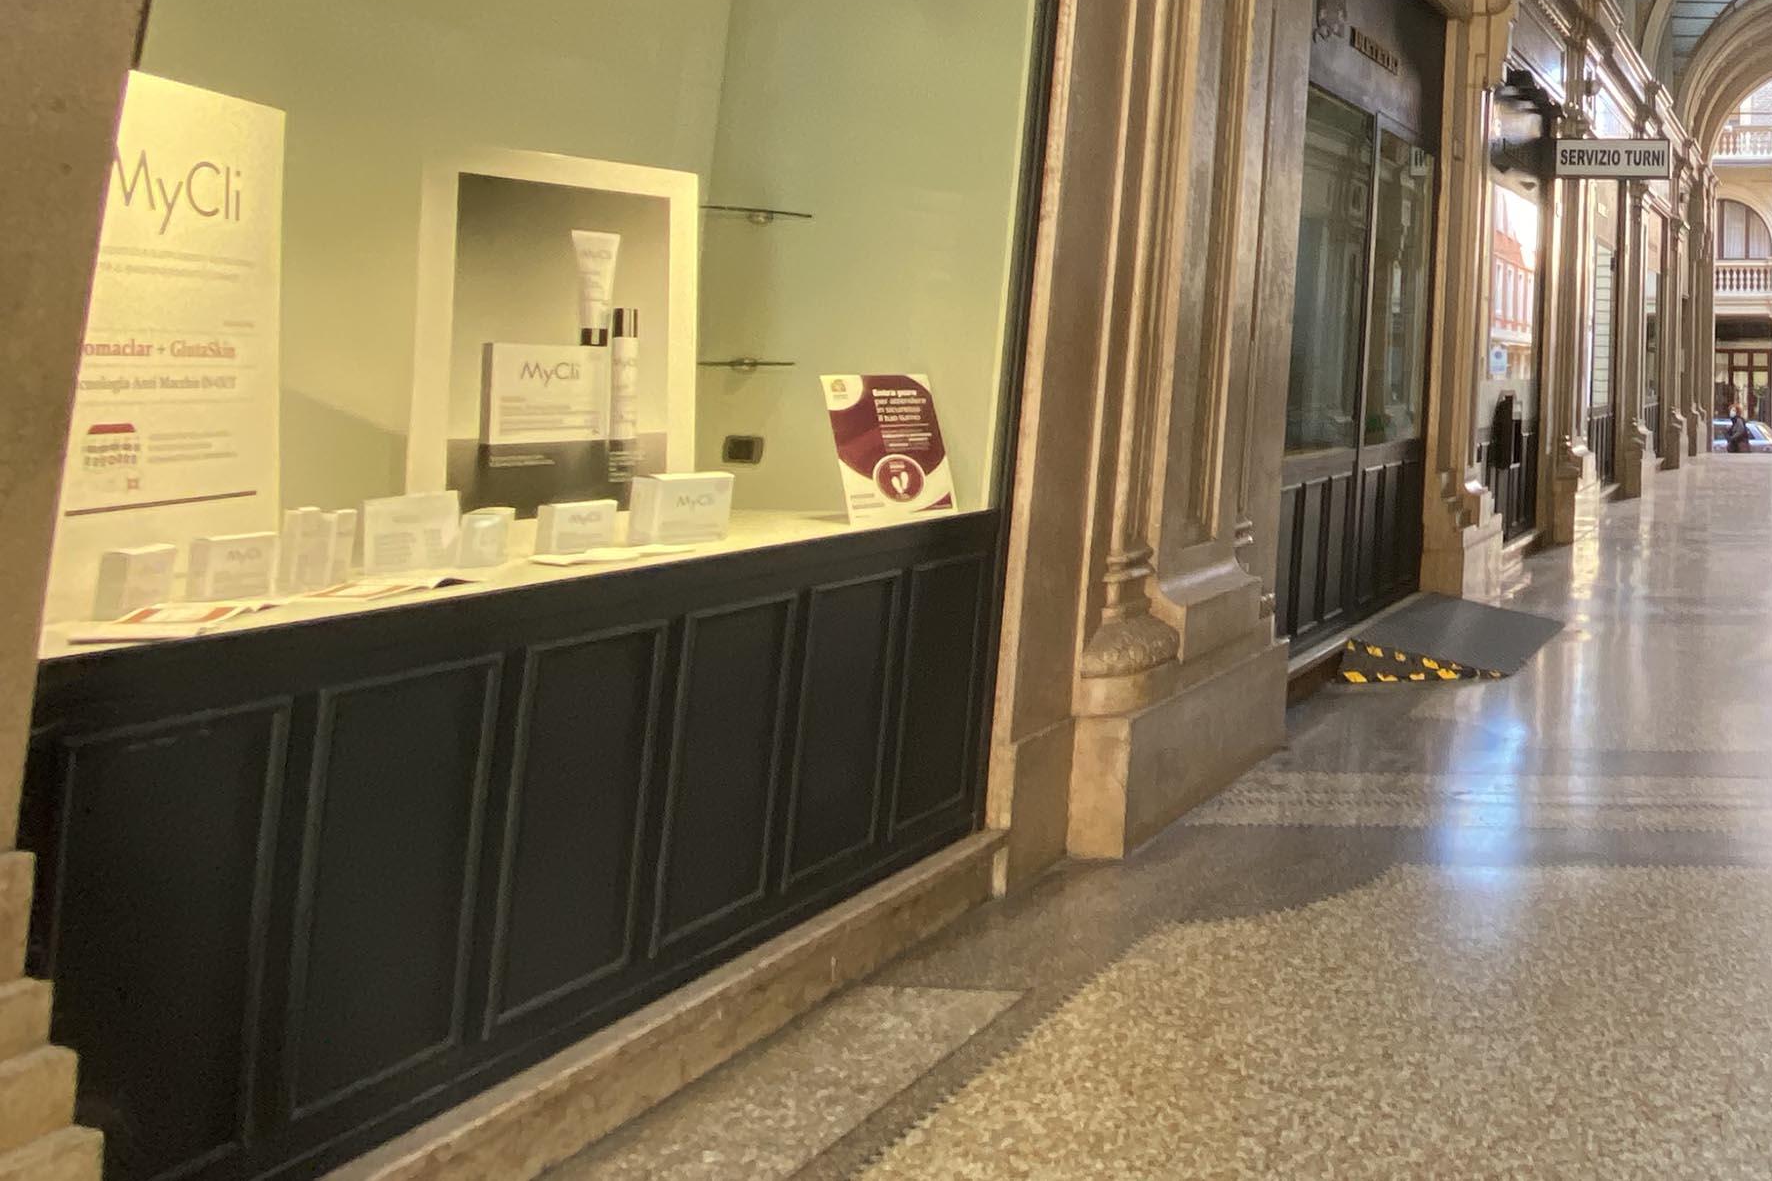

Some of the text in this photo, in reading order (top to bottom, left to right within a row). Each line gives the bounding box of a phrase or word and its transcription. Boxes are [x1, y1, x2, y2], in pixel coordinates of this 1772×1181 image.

[1560, 149, 1665, 167] SERVIZIO TURNI
[519, 360, 582, 388] MyCli
